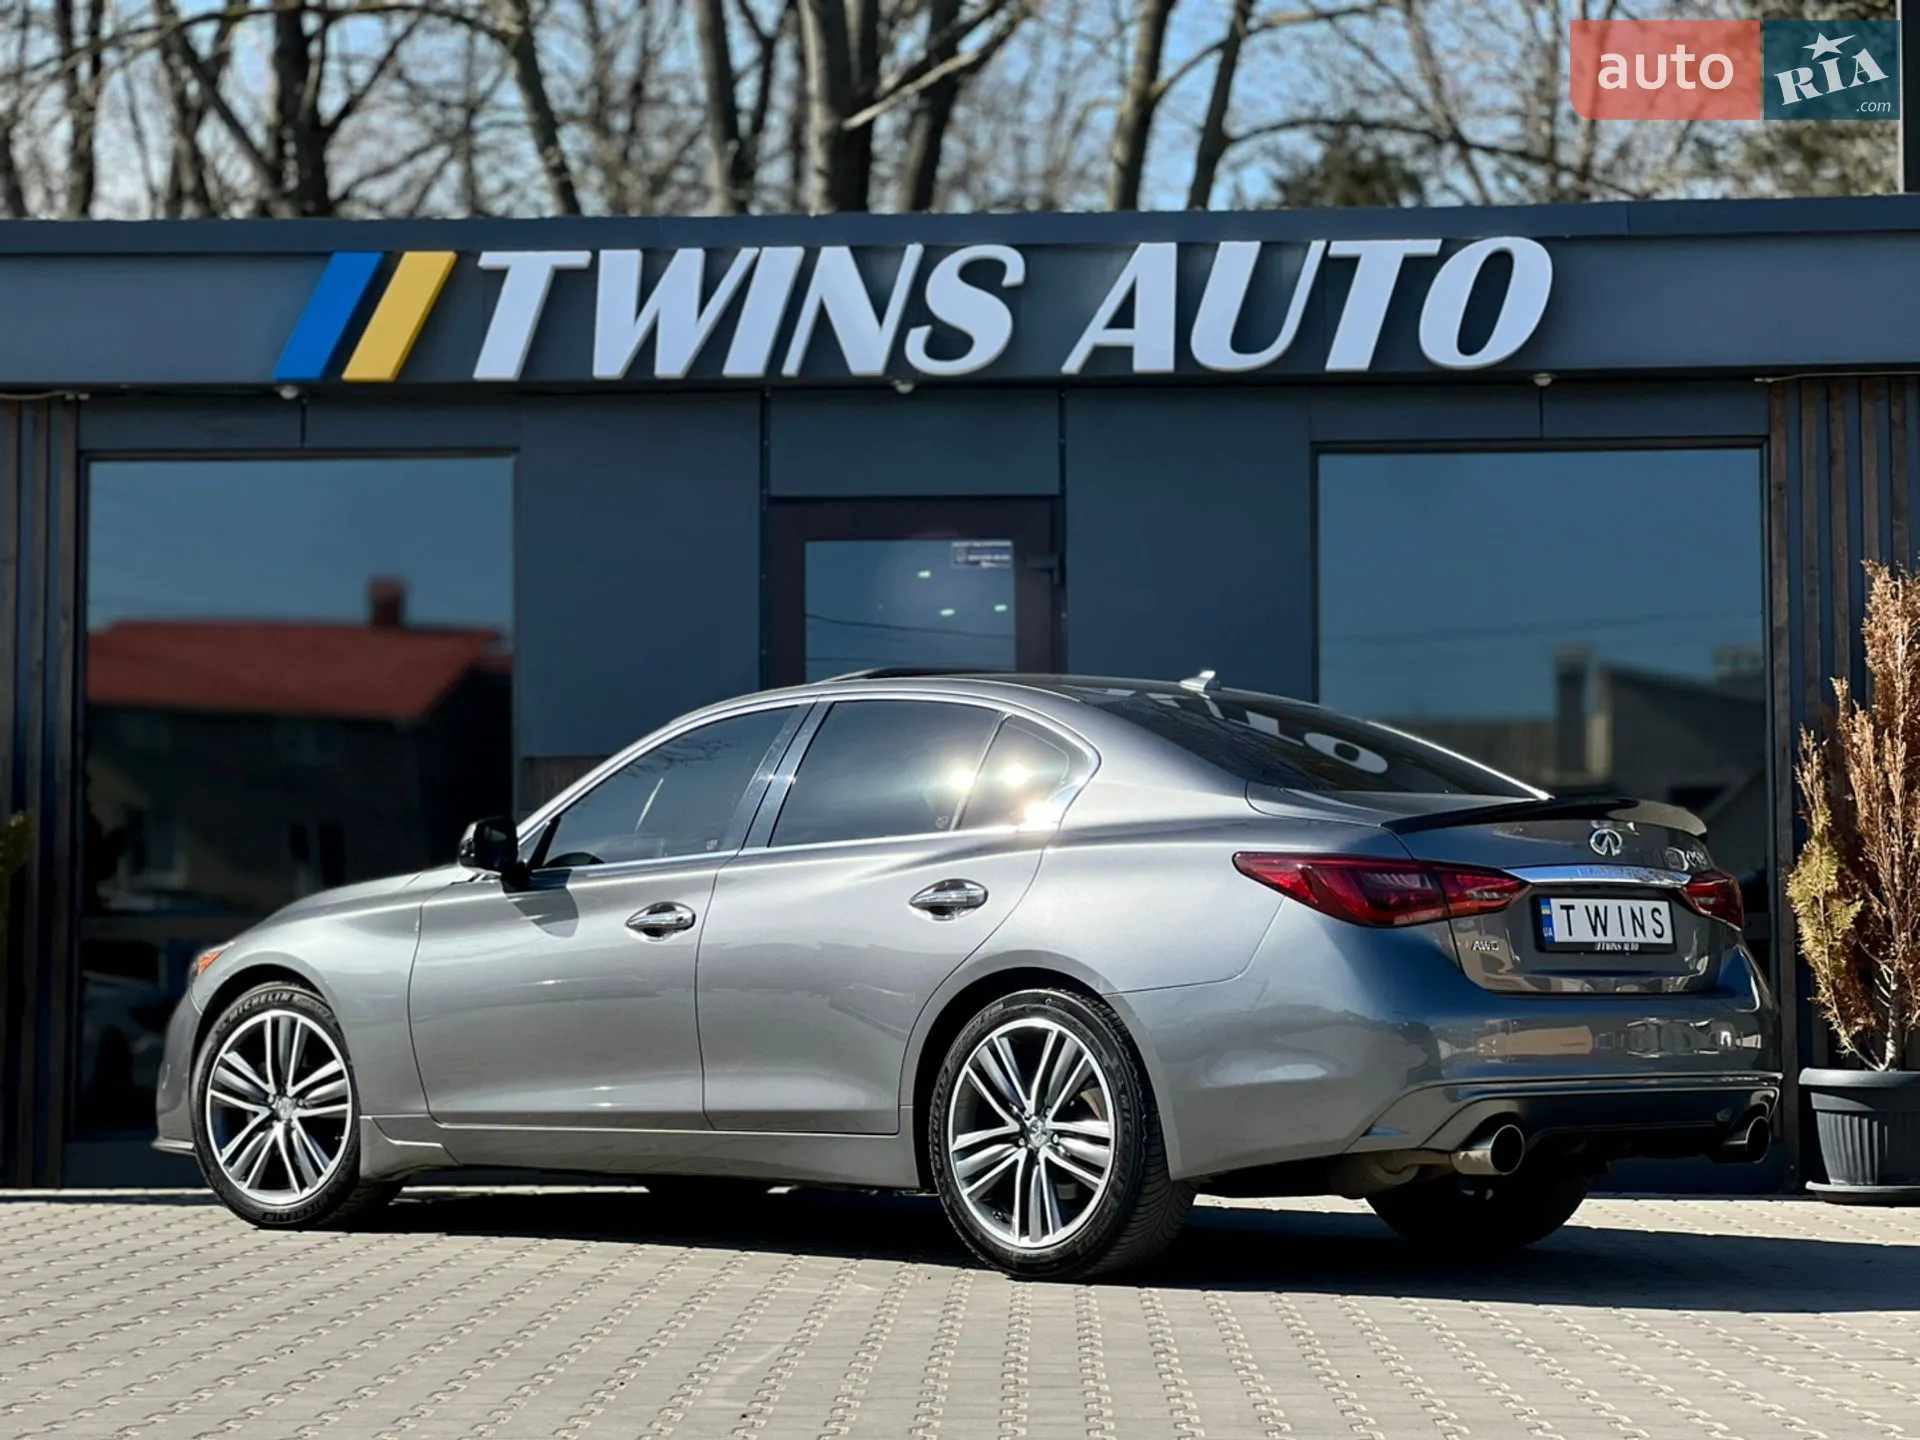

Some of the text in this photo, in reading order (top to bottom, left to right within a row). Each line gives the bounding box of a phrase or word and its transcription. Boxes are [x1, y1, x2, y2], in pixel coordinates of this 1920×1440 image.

[473, 236, 1553, 381] TWINS AUTO
[1560, 904, 1665, 938] TWINS
[228, 992, 291, 1023] MICHELIN
